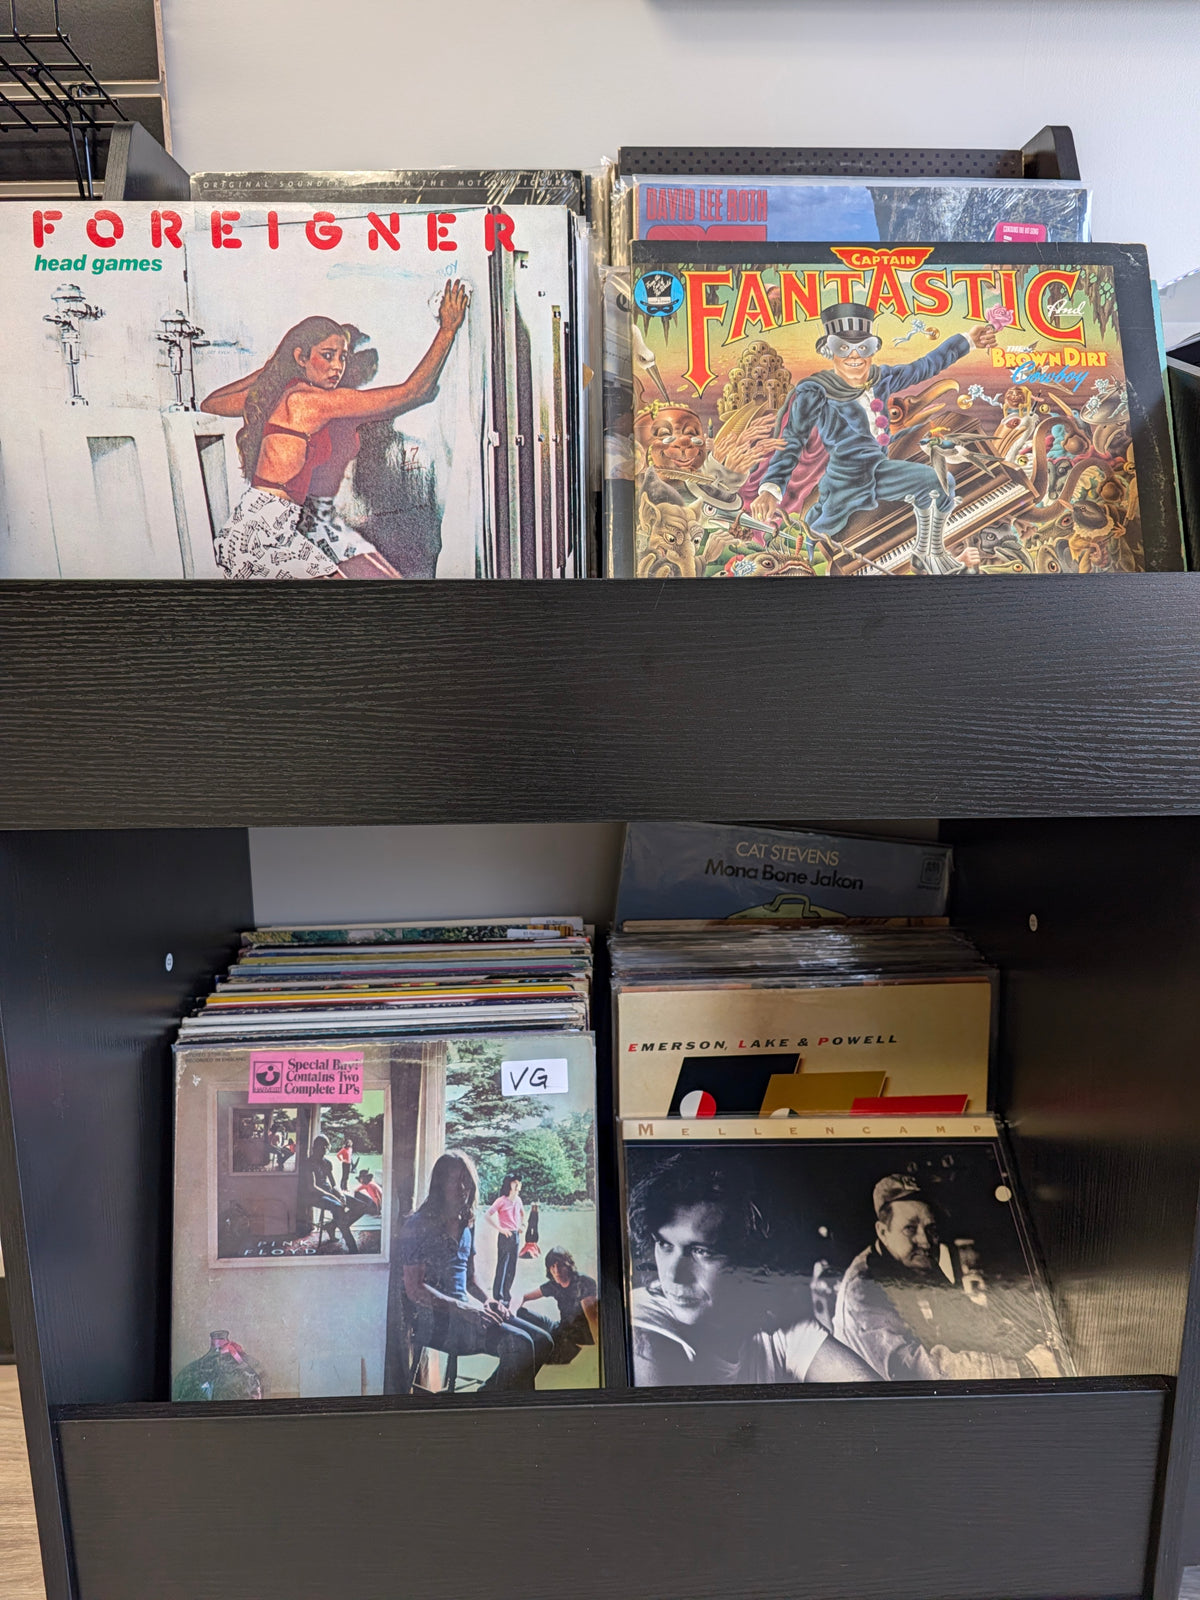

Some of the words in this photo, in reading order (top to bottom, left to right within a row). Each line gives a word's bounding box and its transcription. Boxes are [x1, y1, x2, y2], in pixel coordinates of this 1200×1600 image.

[202, 180, 269, 189] ORIGINAL
[421, 178, 446, 188] THE
[646, 187, 696, 221] DAVID
[700, 188, 723, 222] LEE
[726, 189, 768, 222] ROTH
[32, 209, 516, 252] FOREIGNER
[34, 254, 87, 272] head
[91, 258, 163, 276] games
[851, 253, 916, 266] CAPTAIN
[1047, 298, 1086, 318] And
[682, 265, 1087, 398] FANTASTIC
[991, 347, 1063, 368] BROWN
[1062, 346, 1109, 368] DIRT
[1012, 360, 1089, 393] Cowboy
[736, 842, 768, 859] CAT
[771, 845, 840, 867] STEVENS
[704, 858, 759, 881] Mona
[761, 864, 808, 885] Bone
[810, 870, 864, 891] Jakon
[627, 1040, 729, 1052] EMERSON,
[737, 1038, 790, 1049] LAKE
[797, 1037, 809, 1047] &
[817, 1034, 898, 1047] POWELL
[286, 1070, 335, 1082] Contains
[338, 1070, 359, 1082] Two
[288, 1058, 329, 1071] Special
[332, 1058, 359, 1073] Buy!
[509, 1066, 548, 1091] VG
[284, 1082, 336, 1097] Complete
[338, 1082, 360, 1095] LP's
[638, 1123, 982, 1136] MELLENCAMP
[243, 1248, 317, 1256] FLOYD
